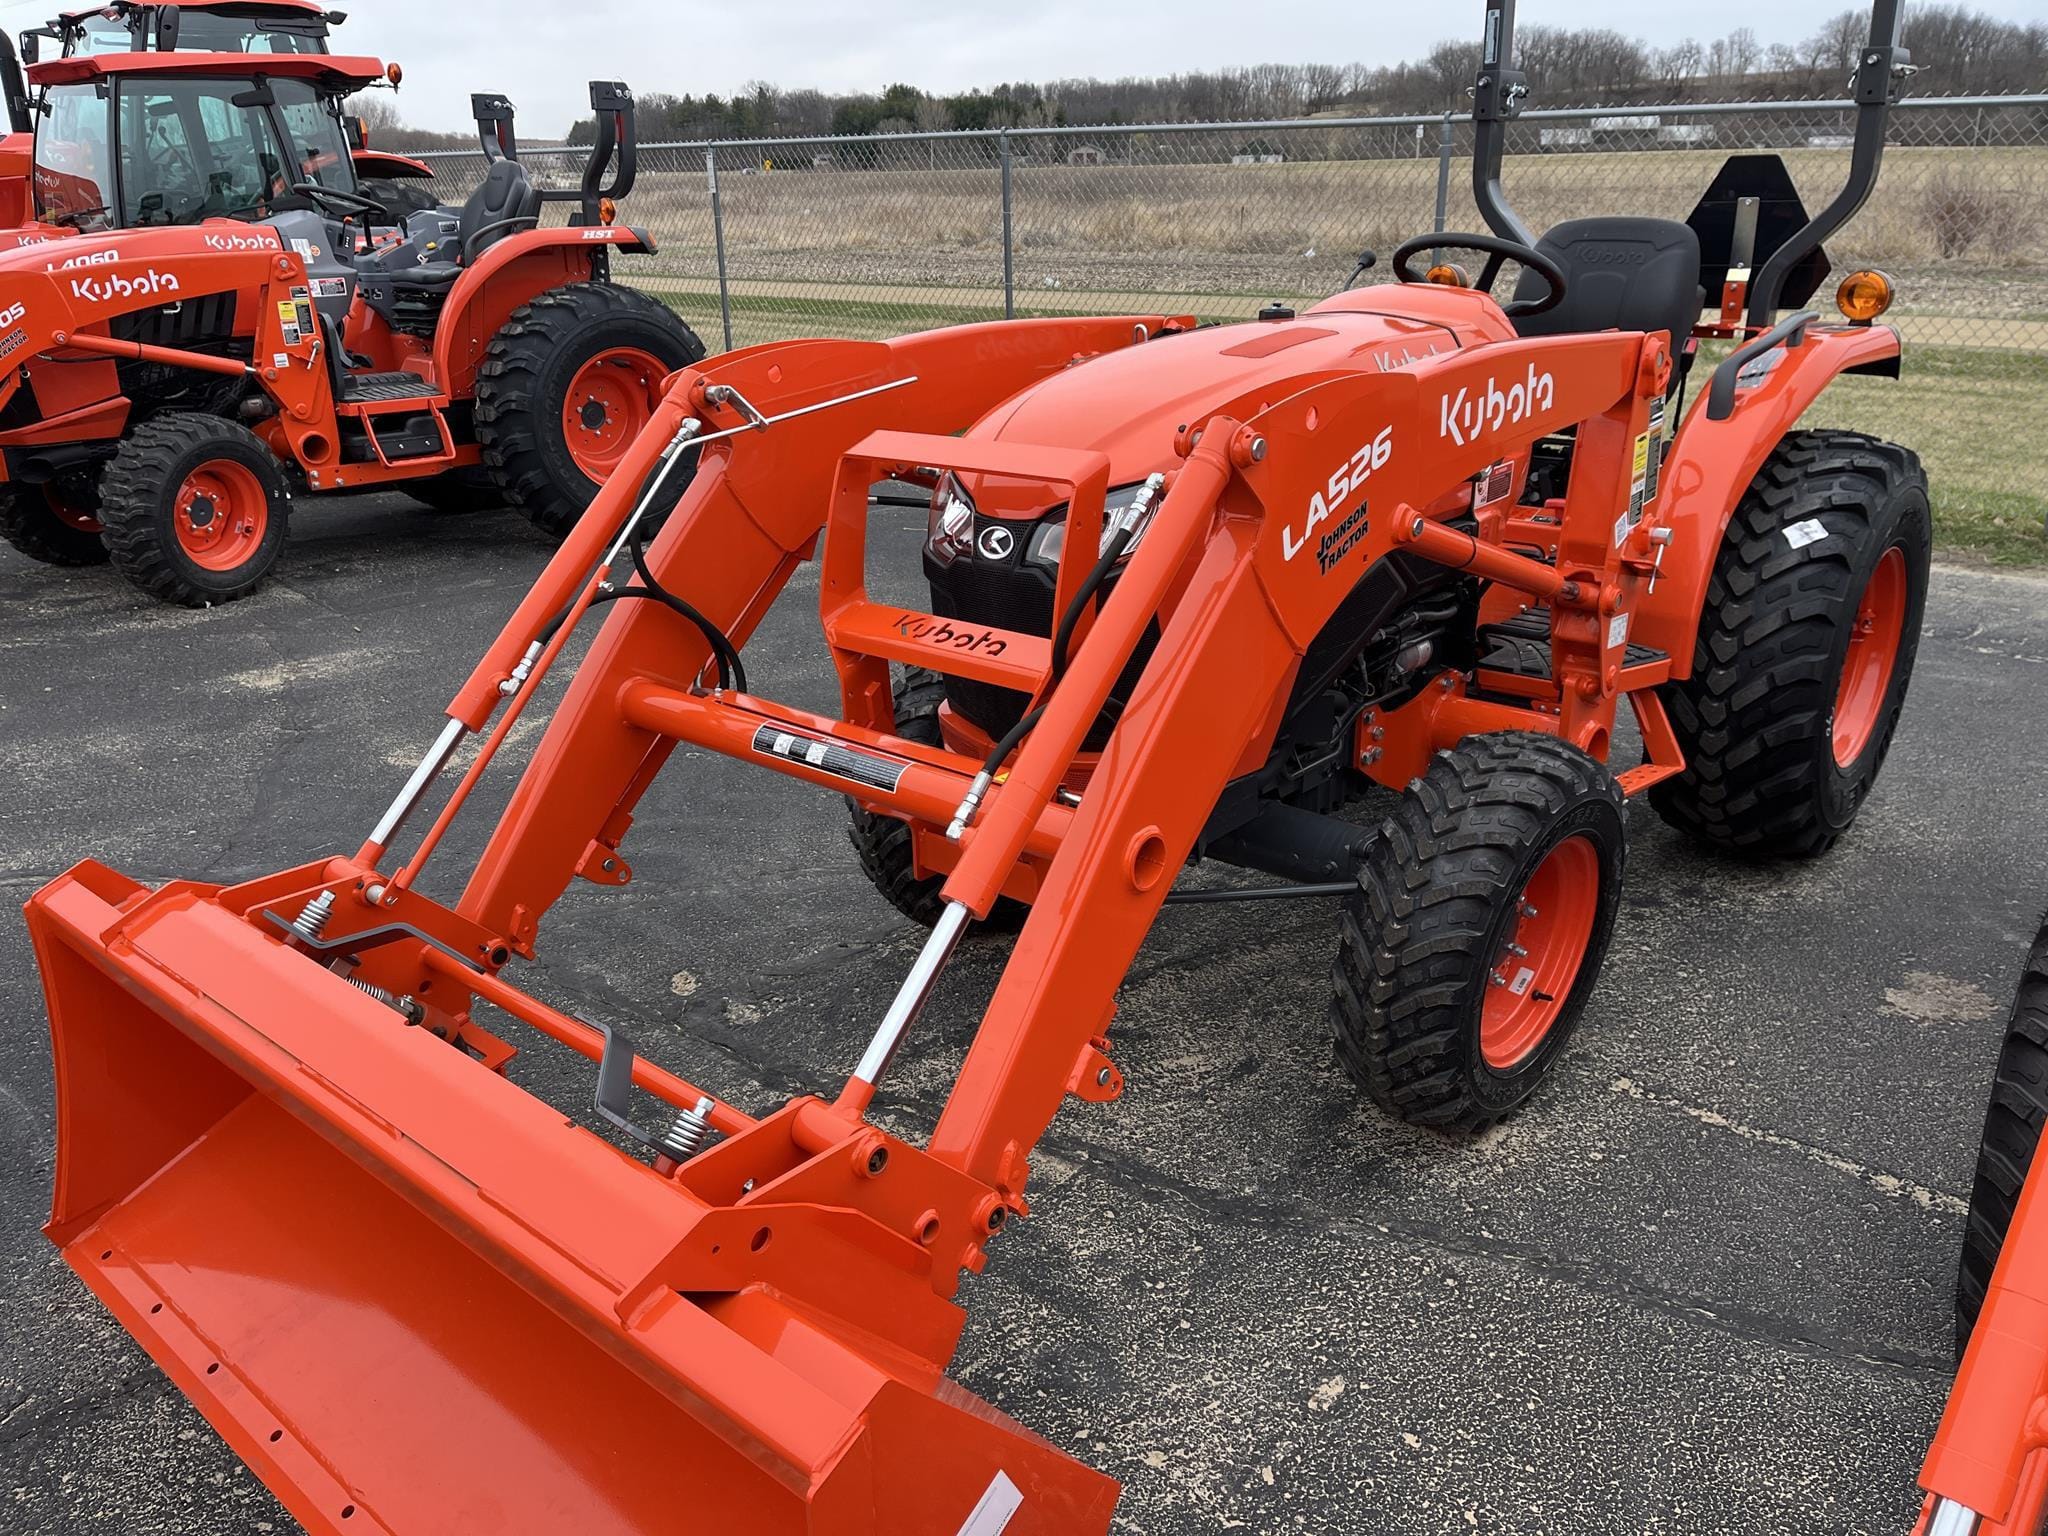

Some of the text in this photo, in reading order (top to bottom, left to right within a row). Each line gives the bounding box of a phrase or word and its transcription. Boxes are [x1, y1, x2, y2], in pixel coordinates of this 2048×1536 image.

[204, 234, 279, 250] Kubota
[582, 230, 615, 239] HST
[71, 269, 180, 302] Kubota
[1440, 362, 1554, 446] Kubota
[1282, 424, 1393, 561] LA526
[1317, 501, 1368, 558] JOHNSON
[1319, 520, 1368, 576] TRACTOR
[893, 614, 1007, 656] Kubota
